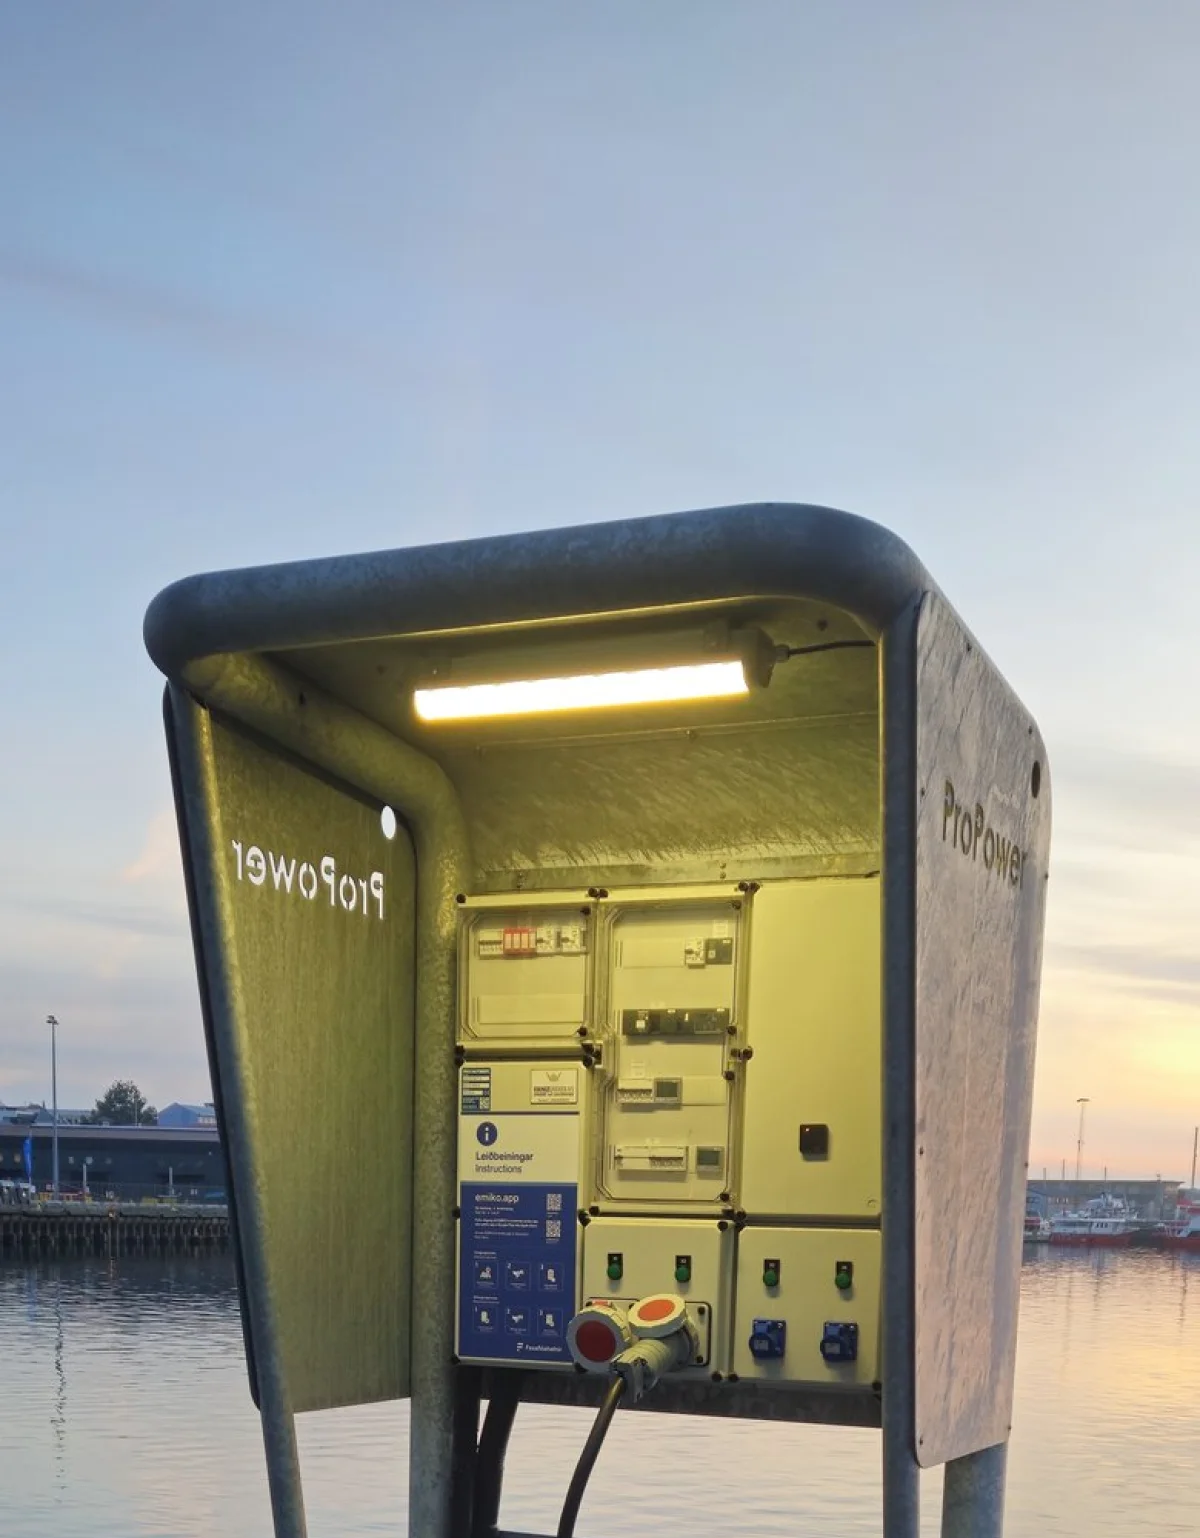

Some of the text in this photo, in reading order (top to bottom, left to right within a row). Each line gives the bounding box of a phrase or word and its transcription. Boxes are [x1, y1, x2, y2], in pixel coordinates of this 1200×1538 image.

[942, 779, 1028, 890] ProPower
[475, 1152, 534, 1163] Leiðbeiningar
[475, 1164, 523, 1173] Instructions
[474, 1192, 519, 1204] emiko.app
